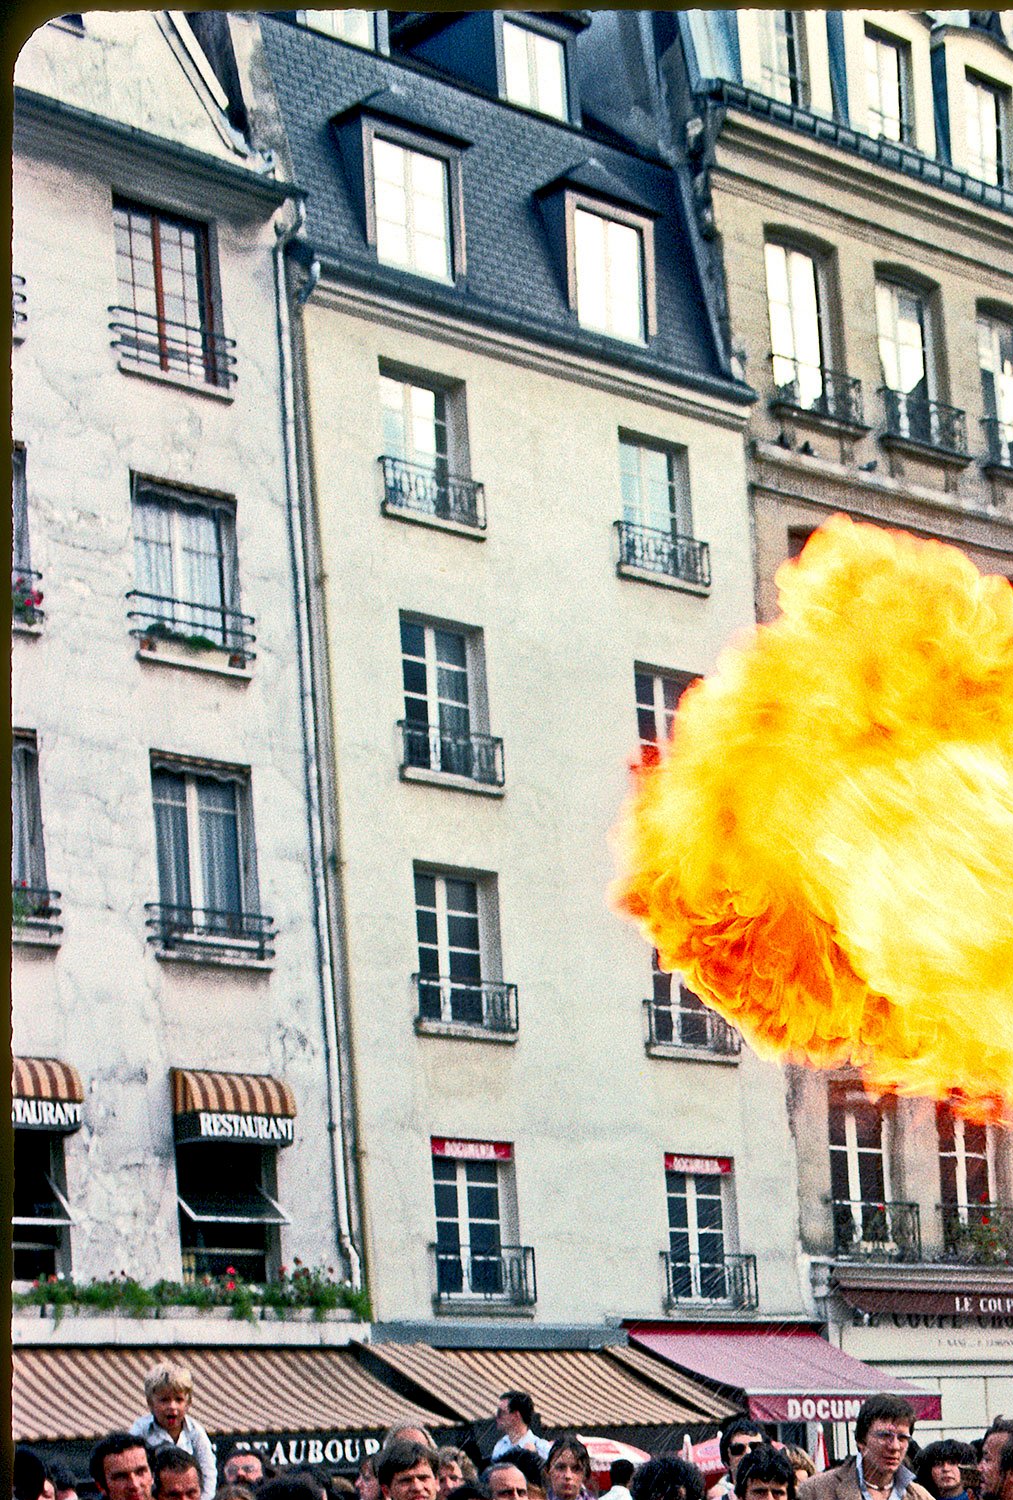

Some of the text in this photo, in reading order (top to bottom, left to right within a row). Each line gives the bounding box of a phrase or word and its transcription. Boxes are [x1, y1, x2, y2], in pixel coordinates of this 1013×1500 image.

[12, 1098, 81, 1126] TAURANT
[200, 1112, 293, 1141] RESTAURANT
[954, 1296, 972, 1313] LE
